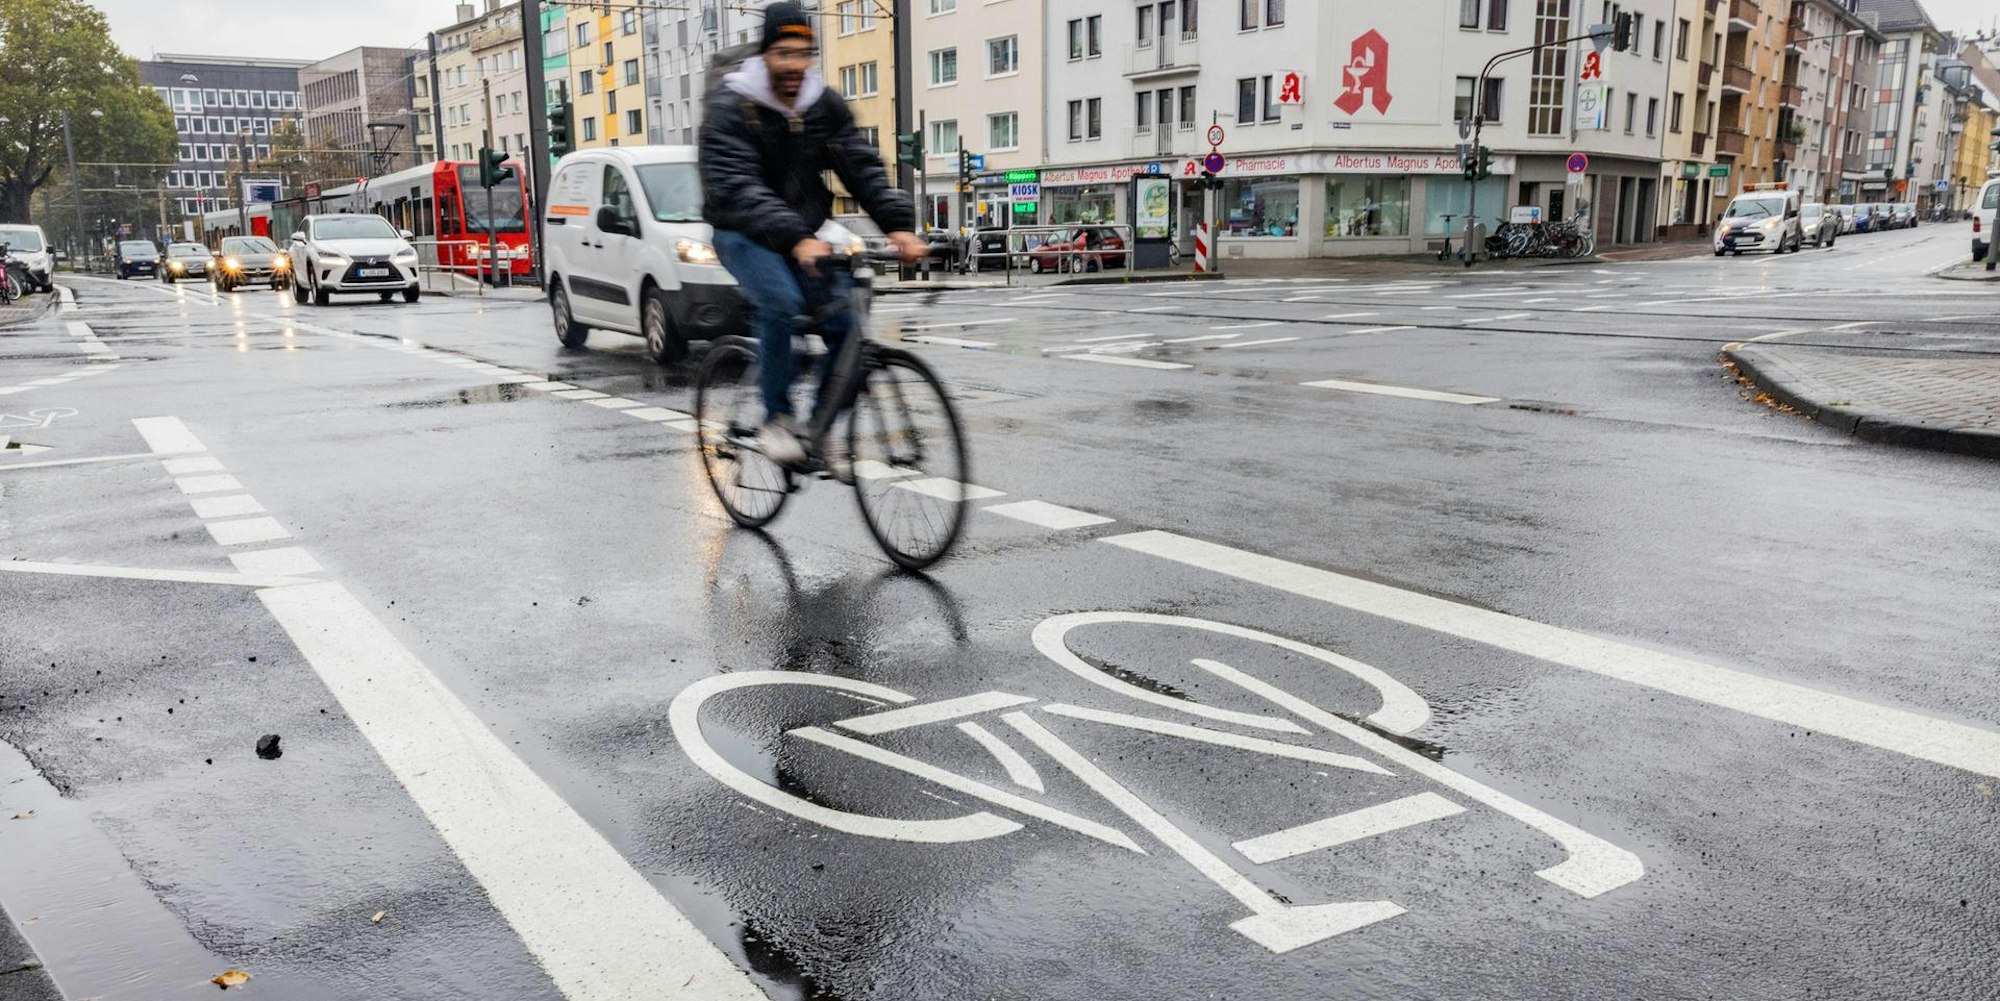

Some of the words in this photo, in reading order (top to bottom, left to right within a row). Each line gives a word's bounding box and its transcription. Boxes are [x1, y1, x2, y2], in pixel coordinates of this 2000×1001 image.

[1211, 130, 1221, 141] 30
[1236, 157, 1286, 172] Pharmacie
[1334, 155, 1381, 169] Albertus
[1386, 155, 1429, 171] Magnus
[1434, 156, 1462, 171] Apot
[1044, 171, 1075, 182] Albertus
[1077, 169, 1108, 182] Magnus
[1012, 184, 1038, 196] KIOSK
